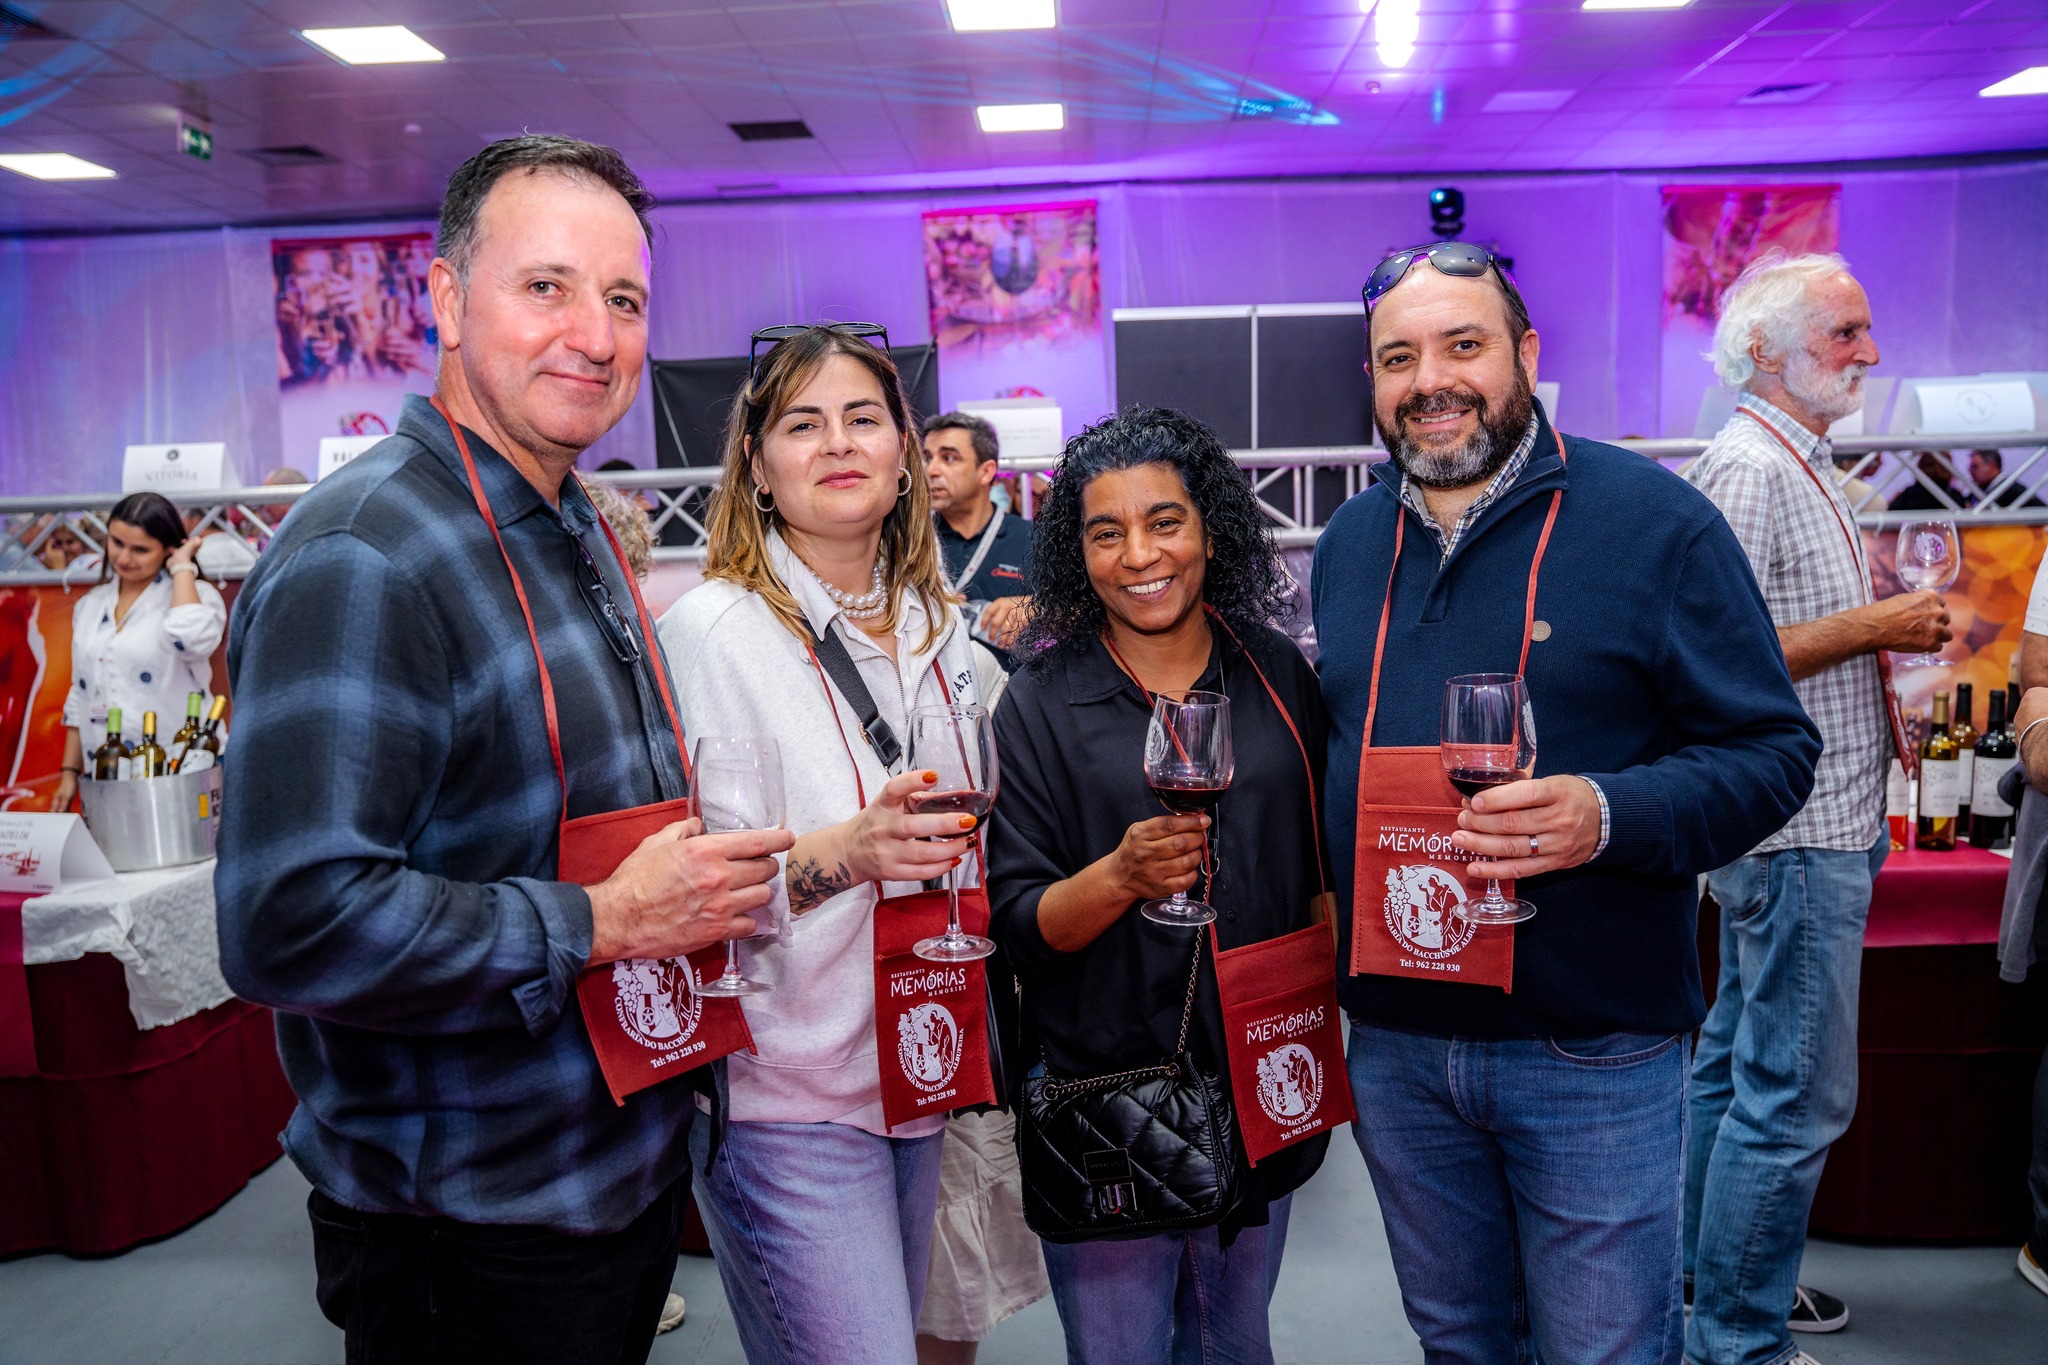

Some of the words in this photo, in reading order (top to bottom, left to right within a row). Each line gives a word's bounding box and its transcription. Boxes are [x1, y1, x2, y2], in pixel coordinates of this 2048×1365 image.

[1428, 854, 1487, 862] MEMORIES
[1383, 897, 1403, 944] CONFRARIA
[1402, 941, 1413, 952] DO
[1413, 948, 1451, 960] BACCHUS
[1450, 943, 1462, 955] DE
[1399, 959, 1414, 967] Tel:
[1415, 960, 1429, 969] 962
[1431, 962, 1445, 971] 228
[1446, 963, 1460, 972] 930
[928, 984, 967, 997] MEMORIES
[614, 996, 644, 1045] CONFRARIA
[644, 1039, 657, 1049] DO
[657, 1031, 692, 1051] BACCHUS
[689, 1020, 698, 1036] DE
[1287, 1020, 1325, 1039] MEMORIES
[650, 1057, 667, 1069] Tel:
[665, 1051, 680, 1063] 962
[679, 1045, 693, 1058] 228
[692, 1040, 707, 1053] 930
[897, 1043, 916, 1086] CONFRARIA
[915, 1080, 924, 1090] DO
[924, 1077, 948, 1092] BACCHUS
[946, 1069, 955, 1081] DE
[953, 1027, 964, 1073] ALBUFEIRA
[916, 1097, 927, 1107] Tel:
[927, 1093, 938, 1103] 962
[937, 1091, 947, 1100] 228
[946, 1088, 957, 1097] 930
[1256, 1084, 1278, 1122] CONFRARIA
[1277, 1117, 1287, 1126] DO
[1287, 1111, 1313, 1127] BACCHUS
[1311, 1102, 1319, 1113] DE
[1315, 1060, 1324, 1103] ALBUFEIRA
[1280, 1132, 1292, 1141] Tel:
[1291, 1127, 1302, 1137] 962
[1302, 1123, 1313, 1133] 228
[1312, 1118, 1323, 1129] 930
